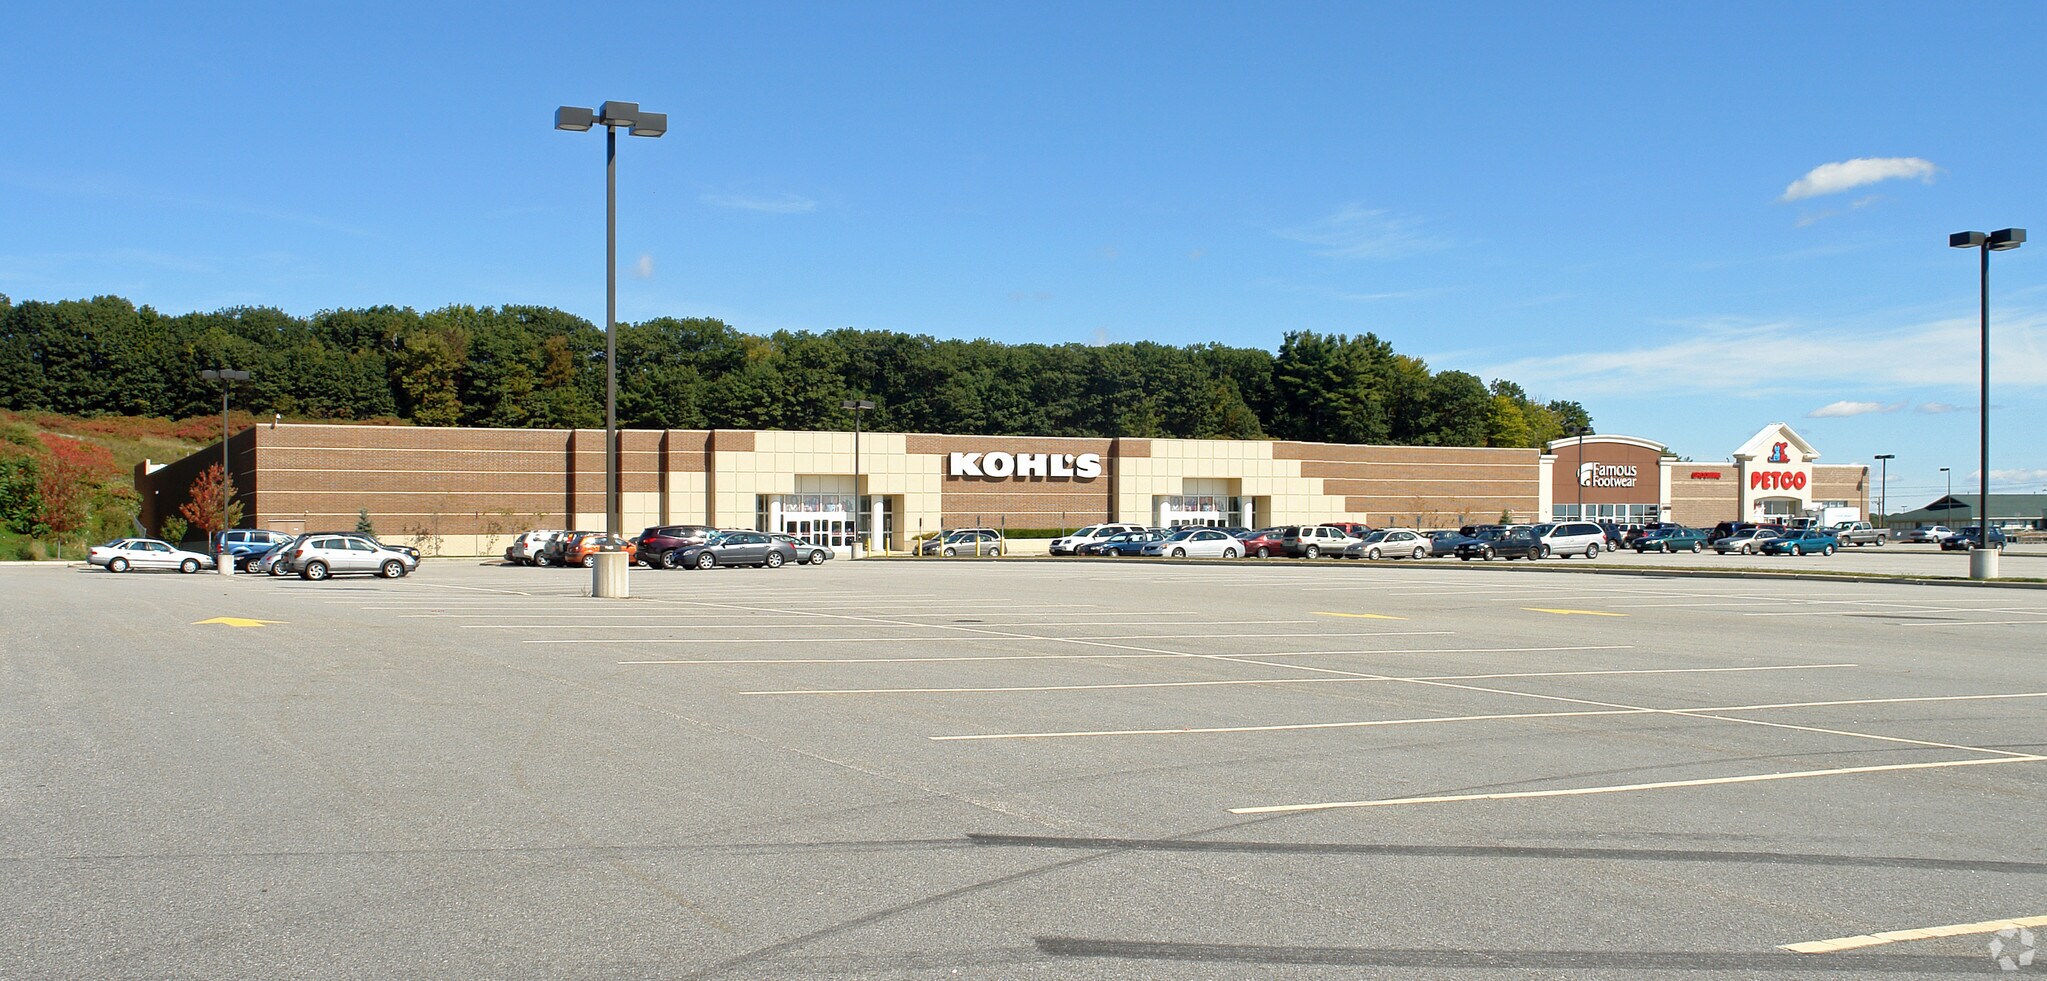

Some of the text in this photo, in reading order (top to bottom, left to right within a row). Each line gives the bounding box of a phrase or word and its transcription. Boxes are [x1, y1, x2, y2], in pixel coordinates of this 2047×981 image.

[950, 451, 1102, 478] KOHL'S
[1593, 462, 1637, 476] Famous
[1593, 475, 1637, 487] Footwear
[1751, 471, 1807, 490] PETCO
